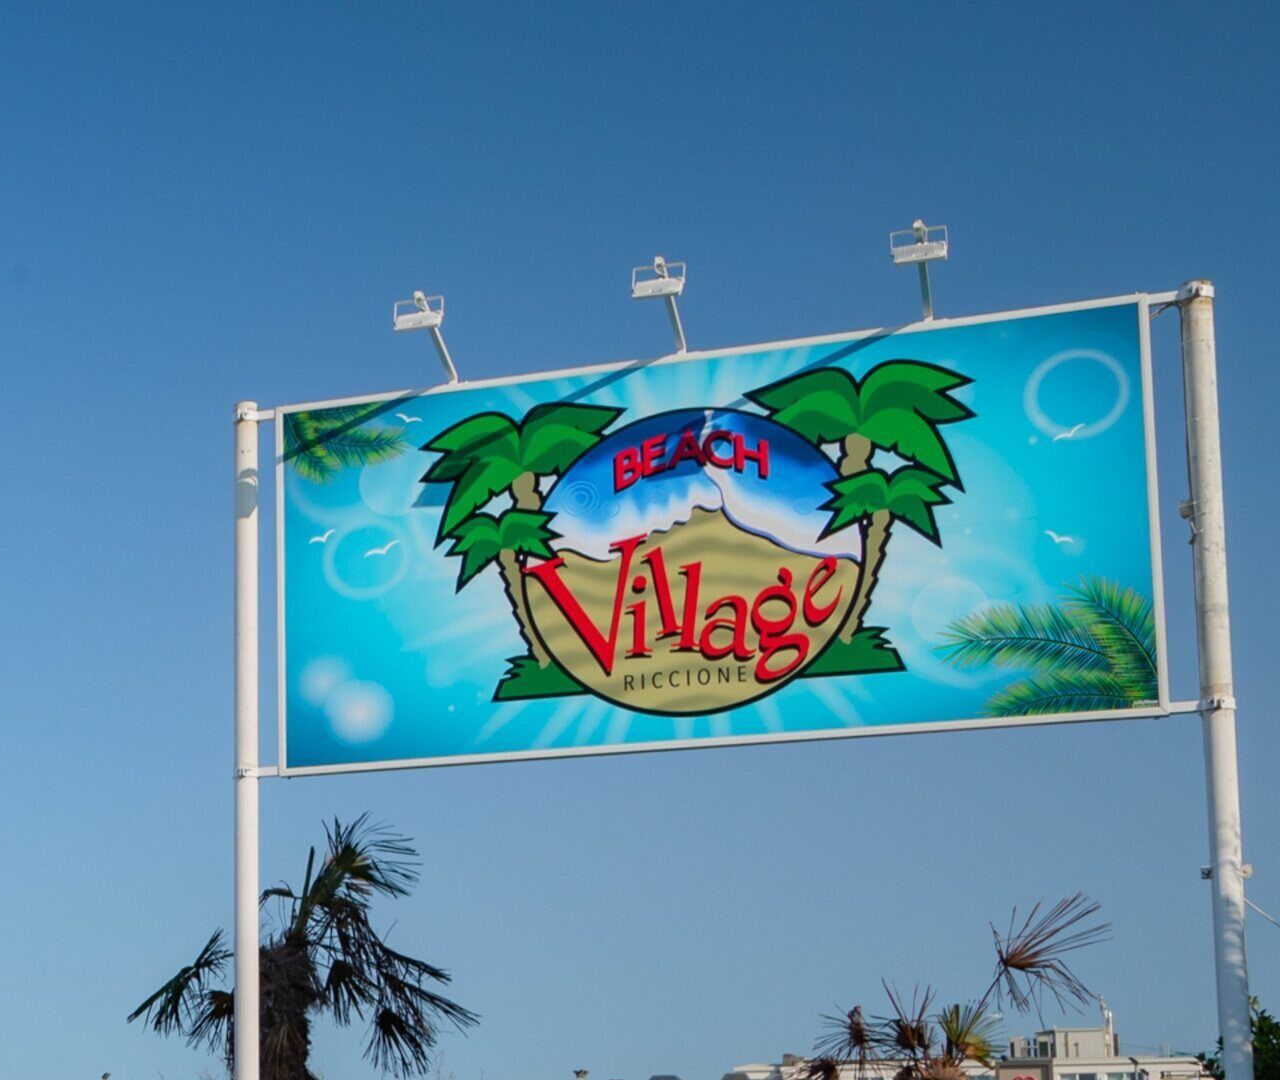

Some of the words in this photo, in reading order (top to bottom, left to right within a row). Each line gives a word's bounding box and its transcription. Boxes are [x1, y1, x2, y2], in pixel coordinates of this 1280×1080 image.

[613, 427, 769, 494] BEACH
[522, 533, 844, 684] Village
[623, 665, 747, 691] RICCIONE
